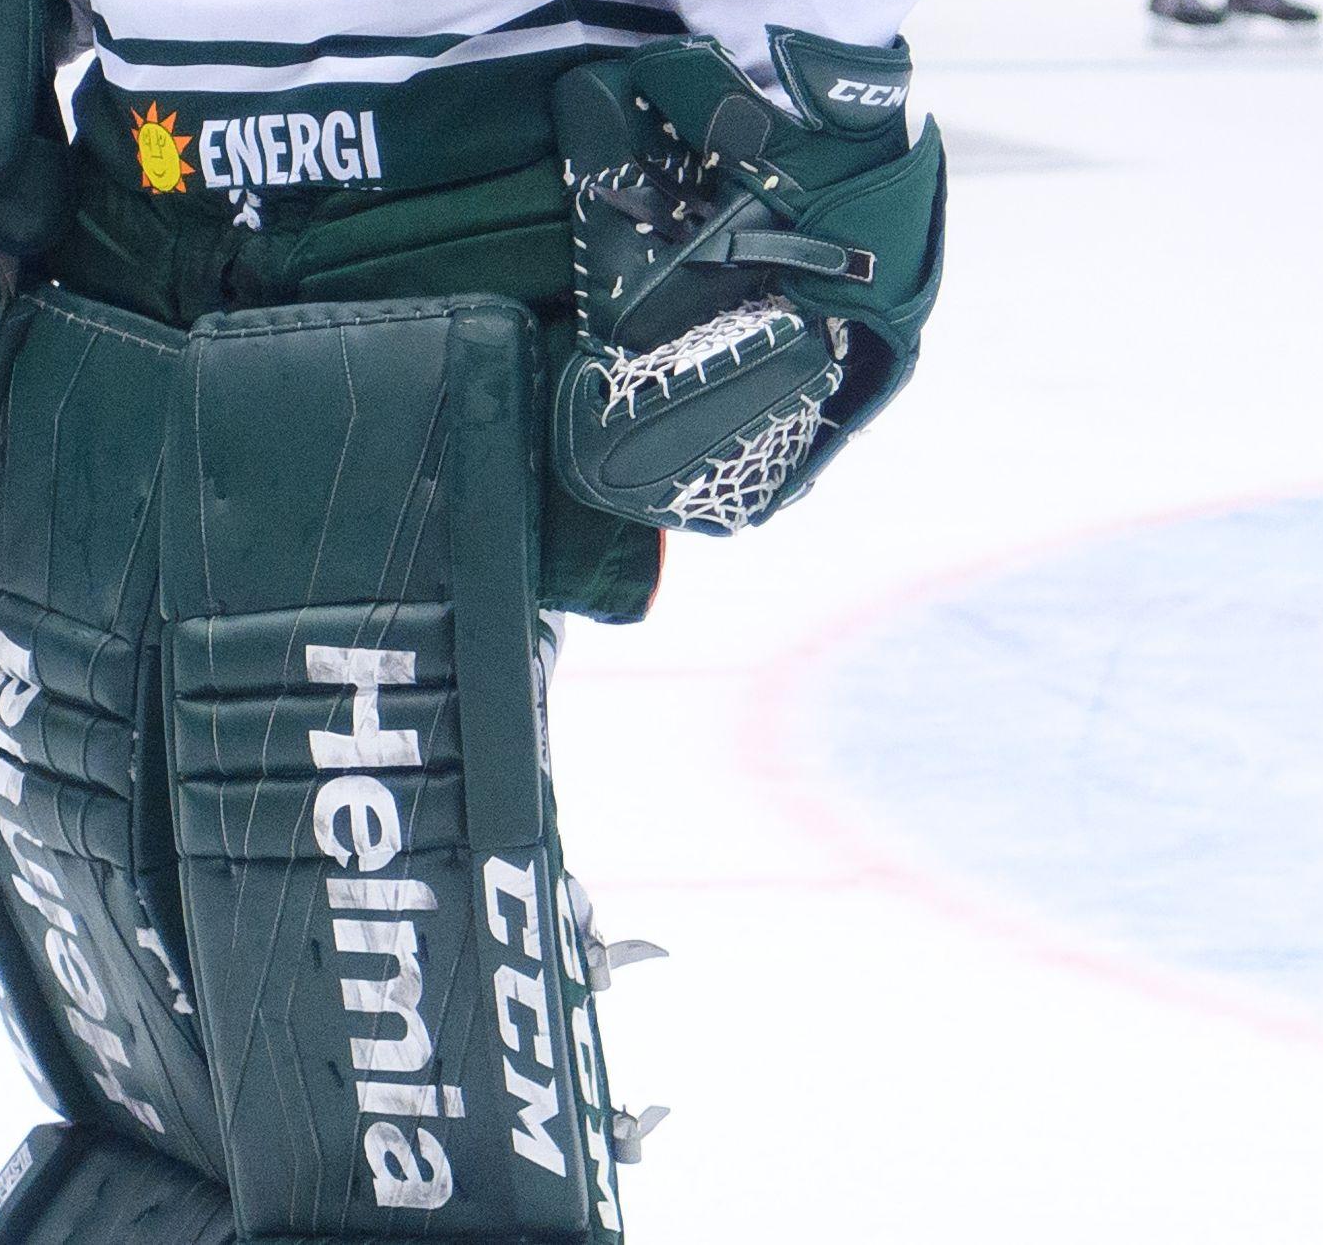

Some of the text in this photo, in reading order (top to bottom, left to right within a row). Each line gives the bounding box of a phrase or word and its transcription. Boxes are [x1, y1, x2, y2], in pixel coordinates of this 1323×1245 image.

[198, 110, 382, 189] ENERGI
[827, 78, 909, 107] CCM
[305, 644, 467, 1212] Helmia
[483, 855, 566, 1178] CCM
